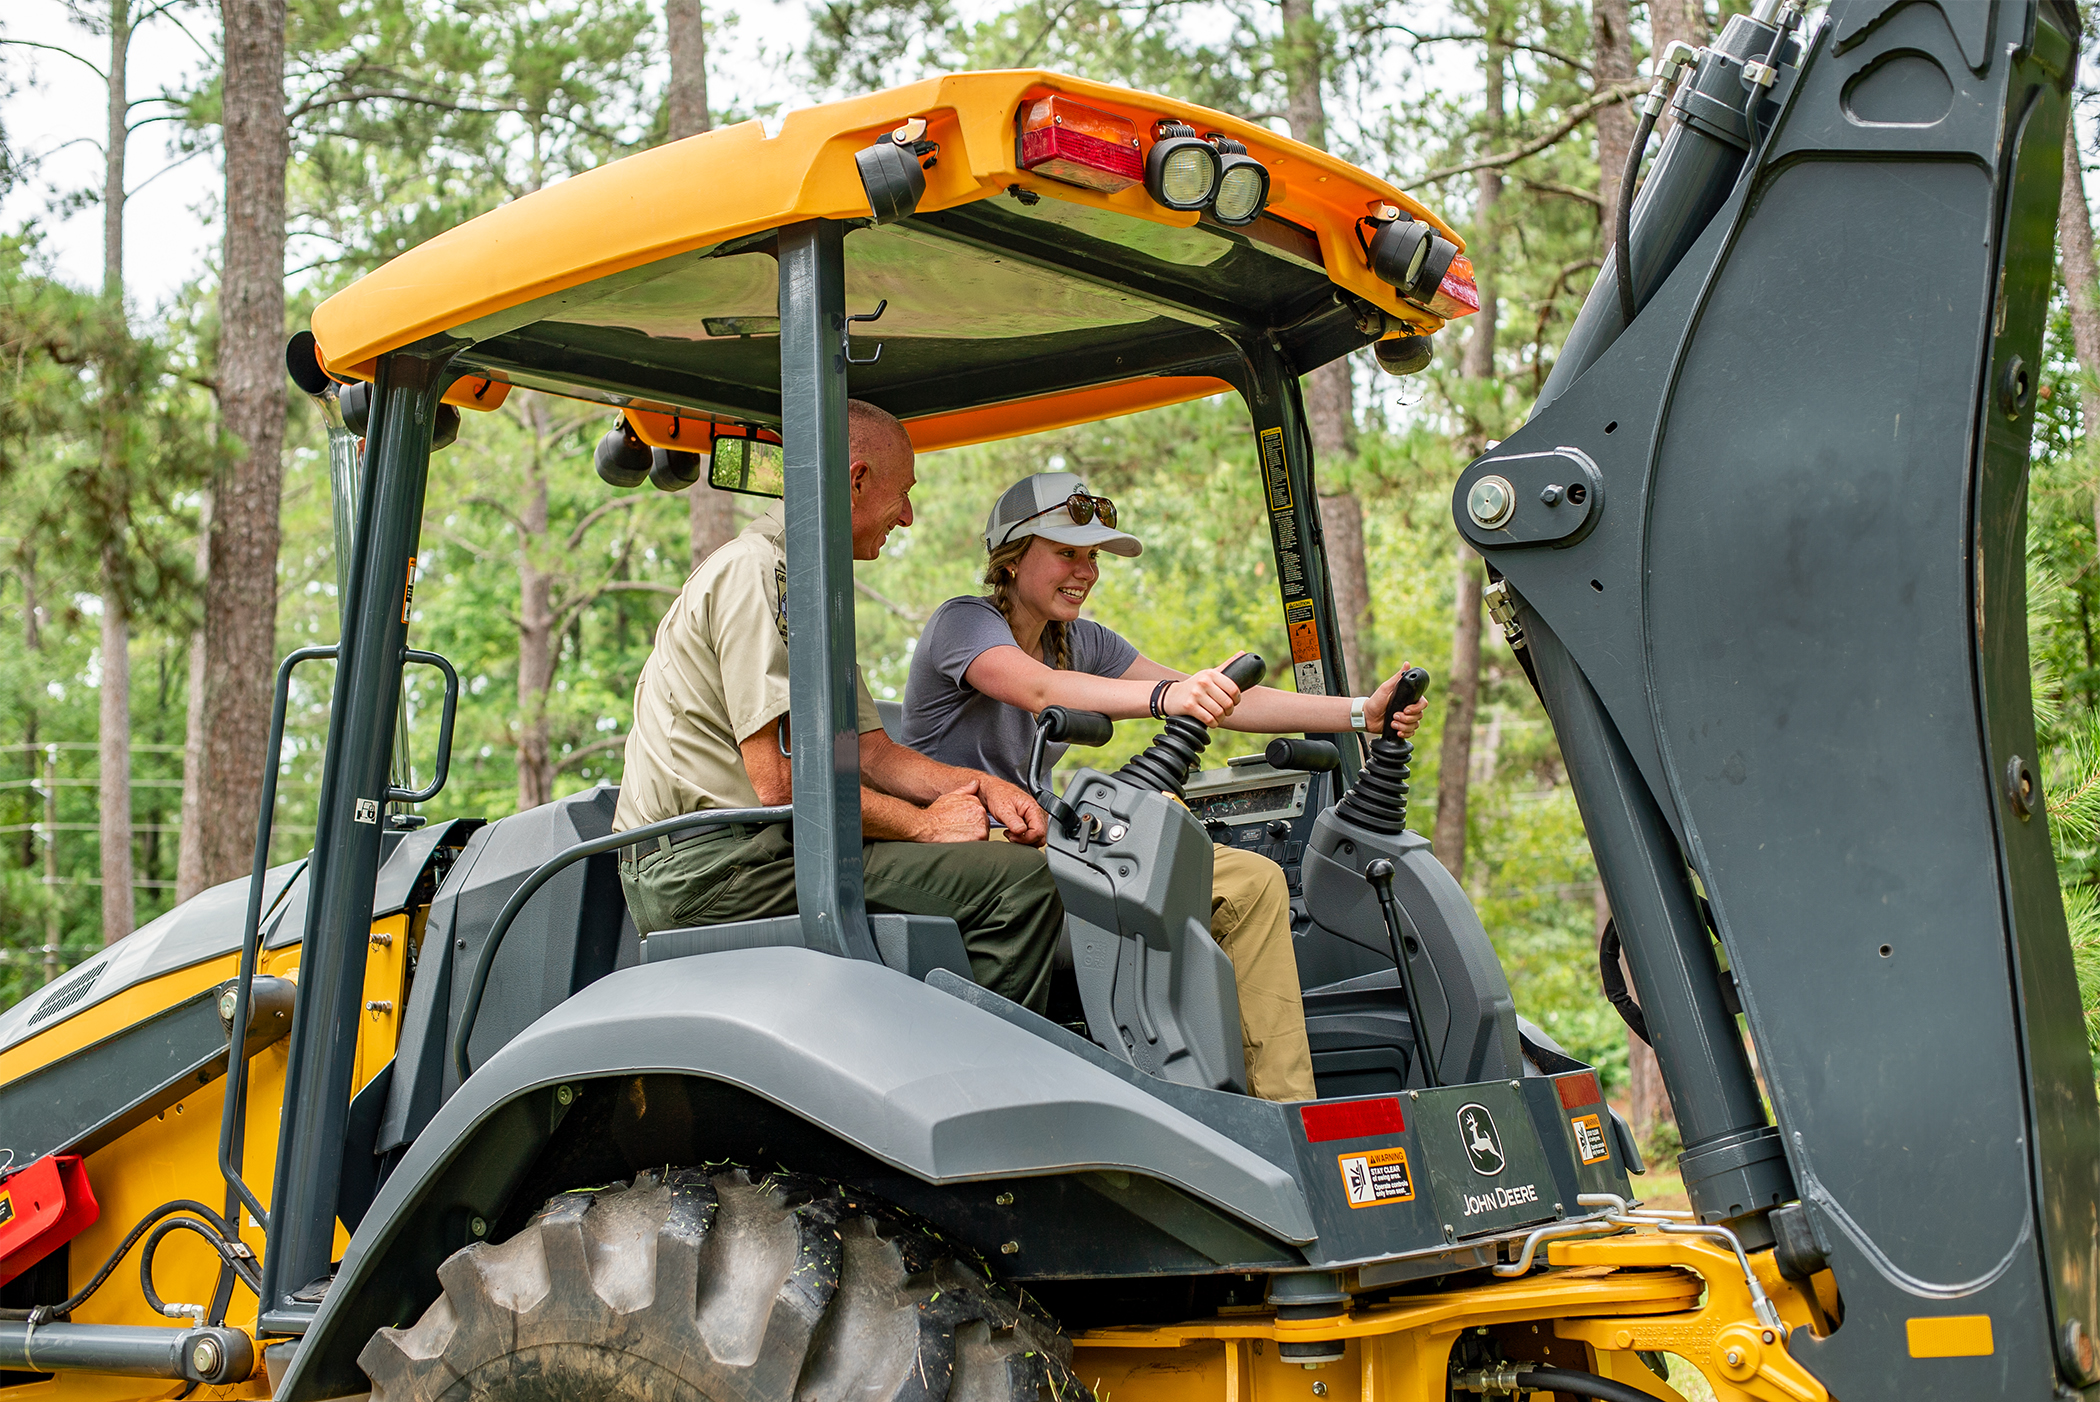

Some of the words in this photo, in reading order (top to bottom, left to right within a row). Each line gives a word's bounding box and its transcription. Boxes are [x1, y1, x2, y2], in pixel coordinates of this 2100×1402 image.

[1375, 1152, 1404, 1163] WARNING
[1370, 1167, 1384, 1175] STAY
[1384, 1165, 1400, 1173] CLEAR
[1374, 1183, 1391, 1191] Operate
[1392, 1180, 1408, 1188] controls
[1376, 1190, 1386, 1198] only
[1463, 1193, 1498, 1216] JOHN
[1495, 1184, 1539, 1208] DEERE
